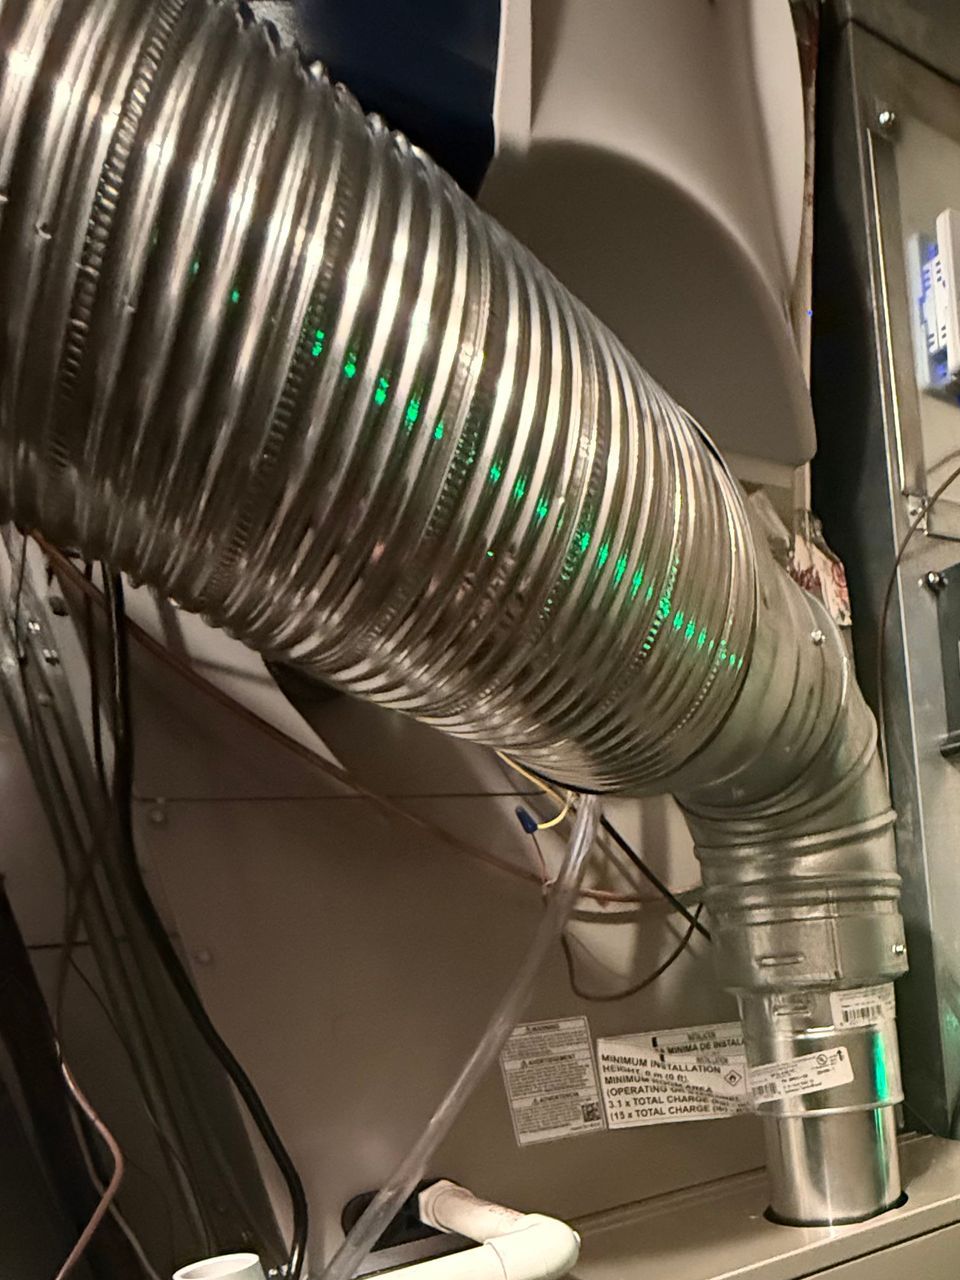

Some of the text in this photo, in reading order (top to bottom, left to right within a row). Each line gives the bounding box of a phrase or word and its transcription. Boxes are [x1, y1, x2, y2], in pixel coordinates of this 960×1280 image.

[601, 1054, 648, 1067] MINIMUM
[650, 1058, 721, 1074] INSTALLATION
[608, 1099, 622, 1108] 3.1
[633, 1096, 664, 1106] TOTAL
[666, 1095, 708, 1104] CHARGE
[610, 1112, 625, 1121] (15
[635, 1107, 666, 1117] TOTAL
[669, 1104, 710, 1115] CHARGE
